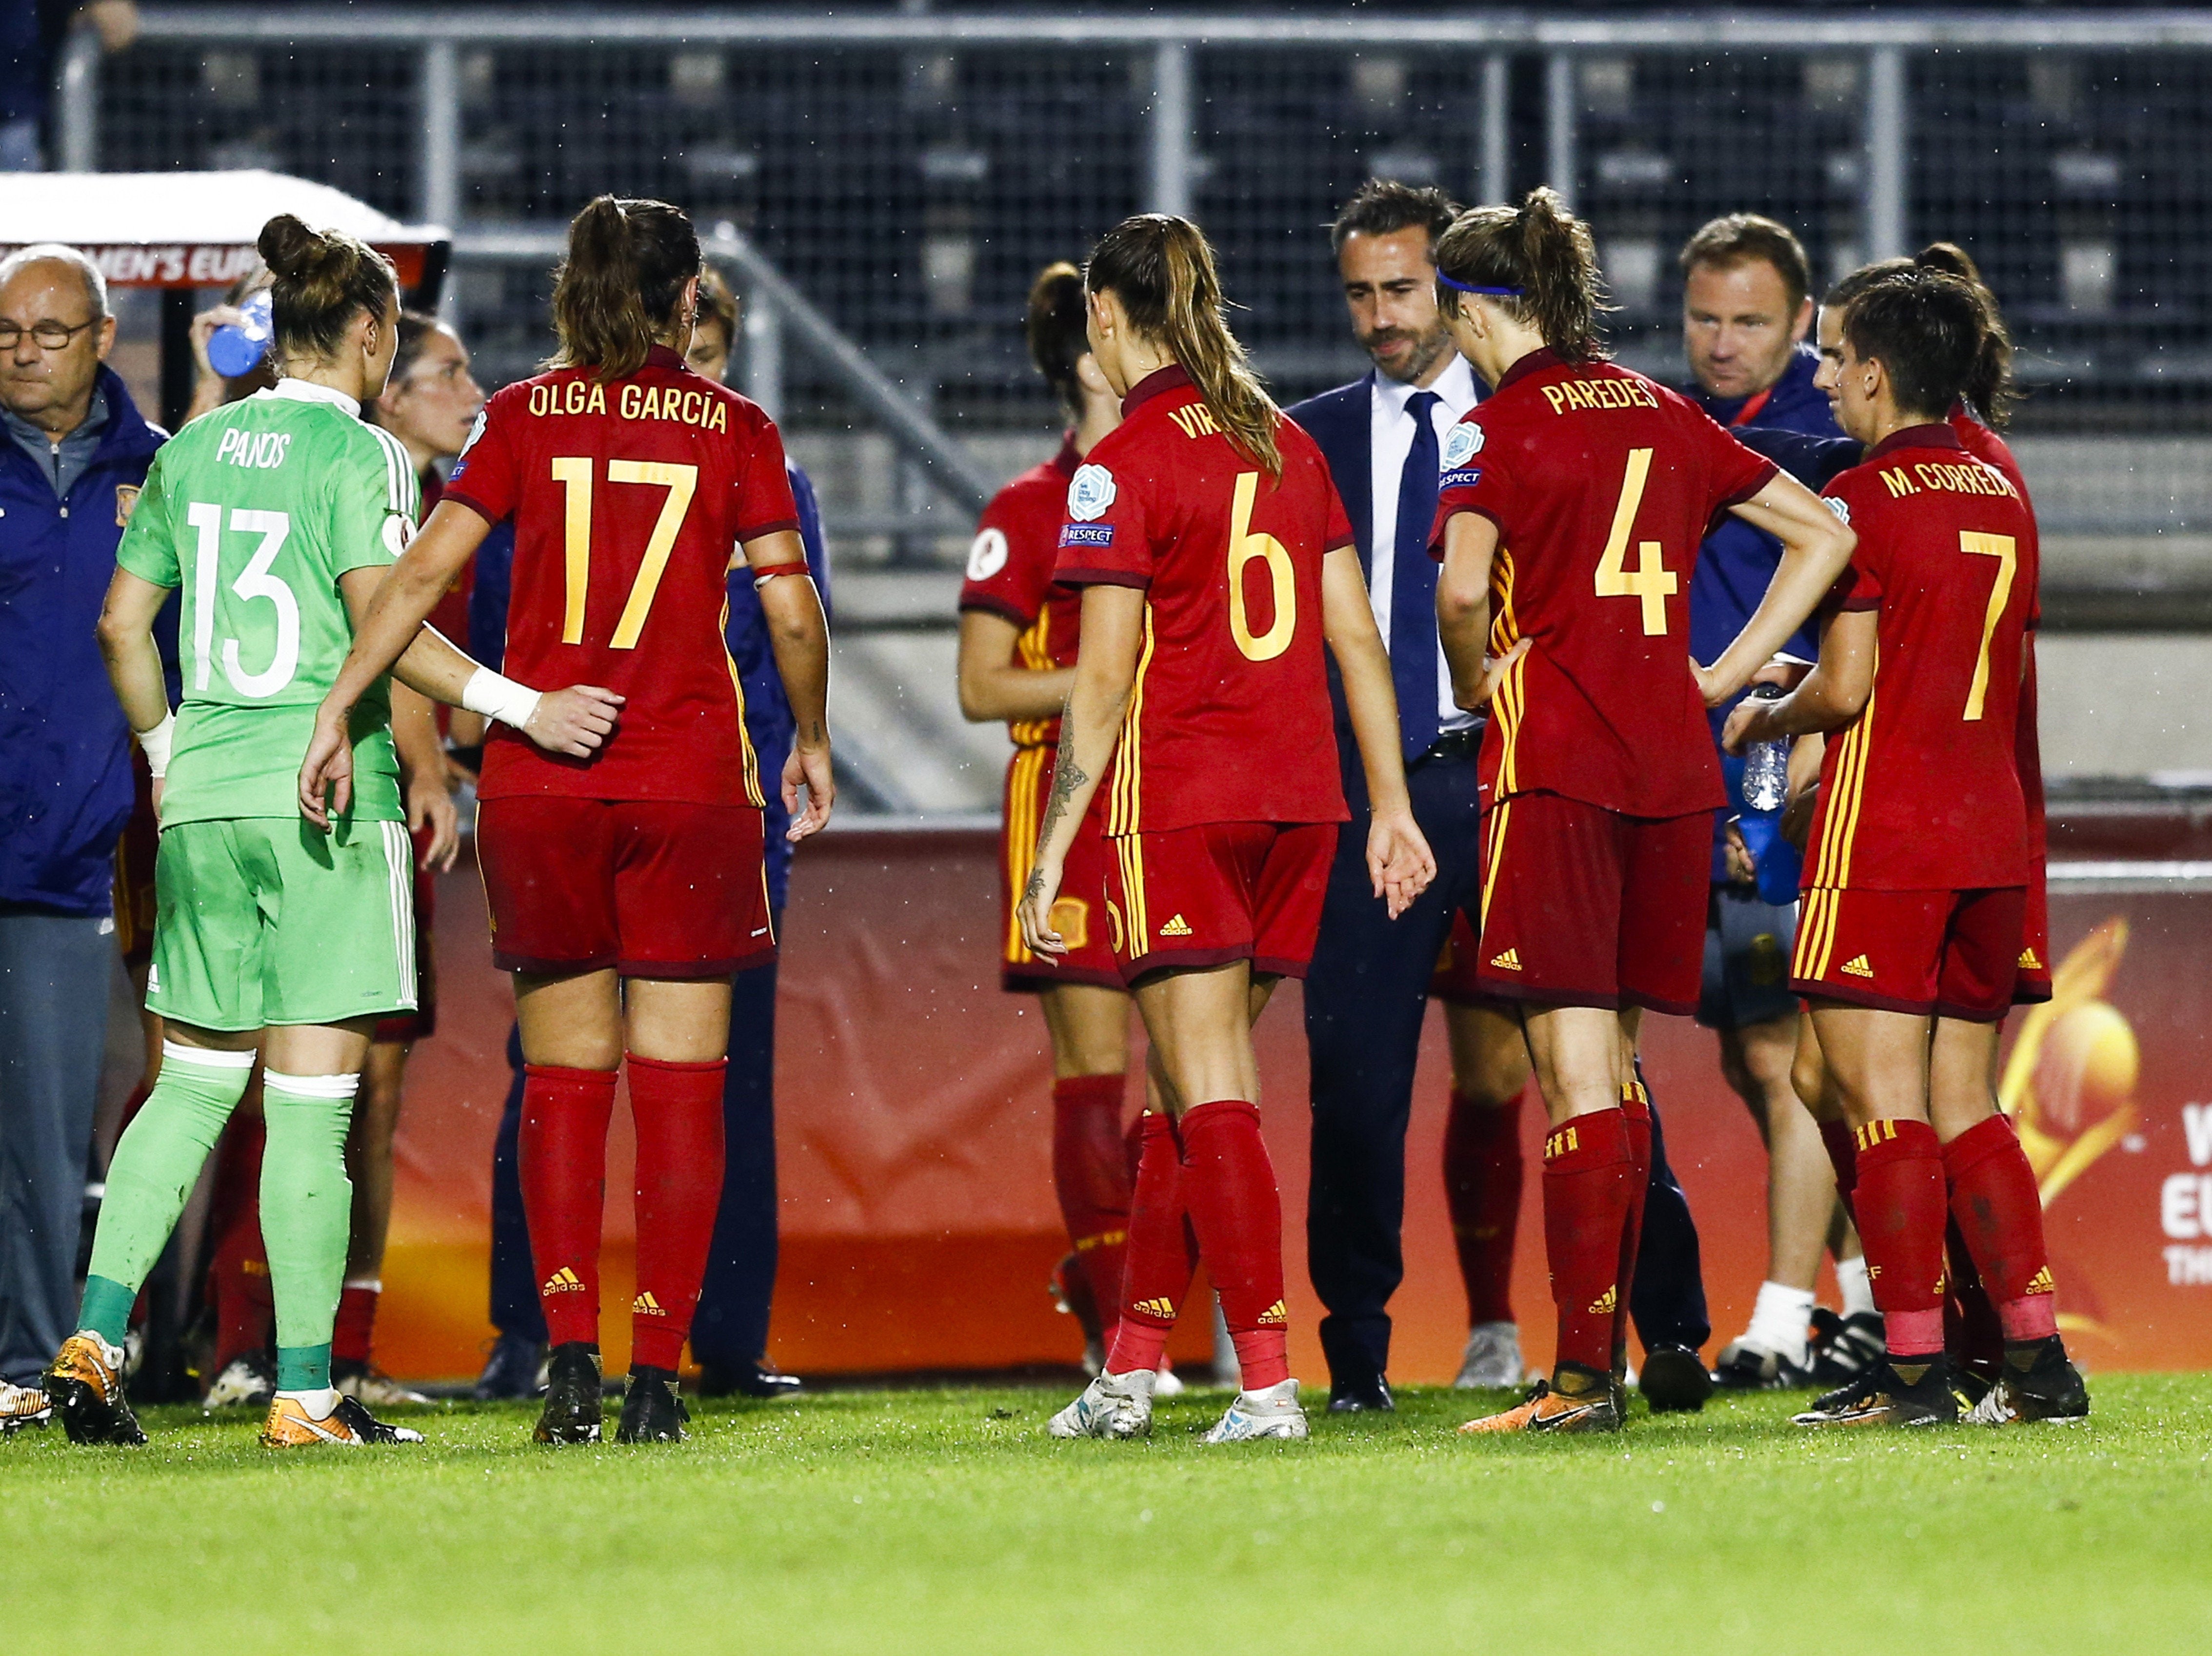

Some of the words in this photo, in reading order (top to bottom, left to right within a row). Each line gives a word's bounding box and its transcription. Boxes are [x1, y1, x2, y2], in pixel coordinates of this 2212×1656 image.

[529, 381, 606, 416] OLGA
[620, 385, 726, 434] GARCÍA
[1168, 403, 1221, 438] VIR
[1541, 379, 1658, 414] PAREDES
[1879, 467, 1921, 498] M.
[551, 456, 698, 650] 17
[1068, 530, 1113, 542] RESPECT
[1594, 448, 1678, 636] 4
[1228, 472, 1296, 661] 6
[187, 502, 300, 698] 13
[1959, 530, 2016, 721] 7
[543, 1283, 585, 1297] adidas
